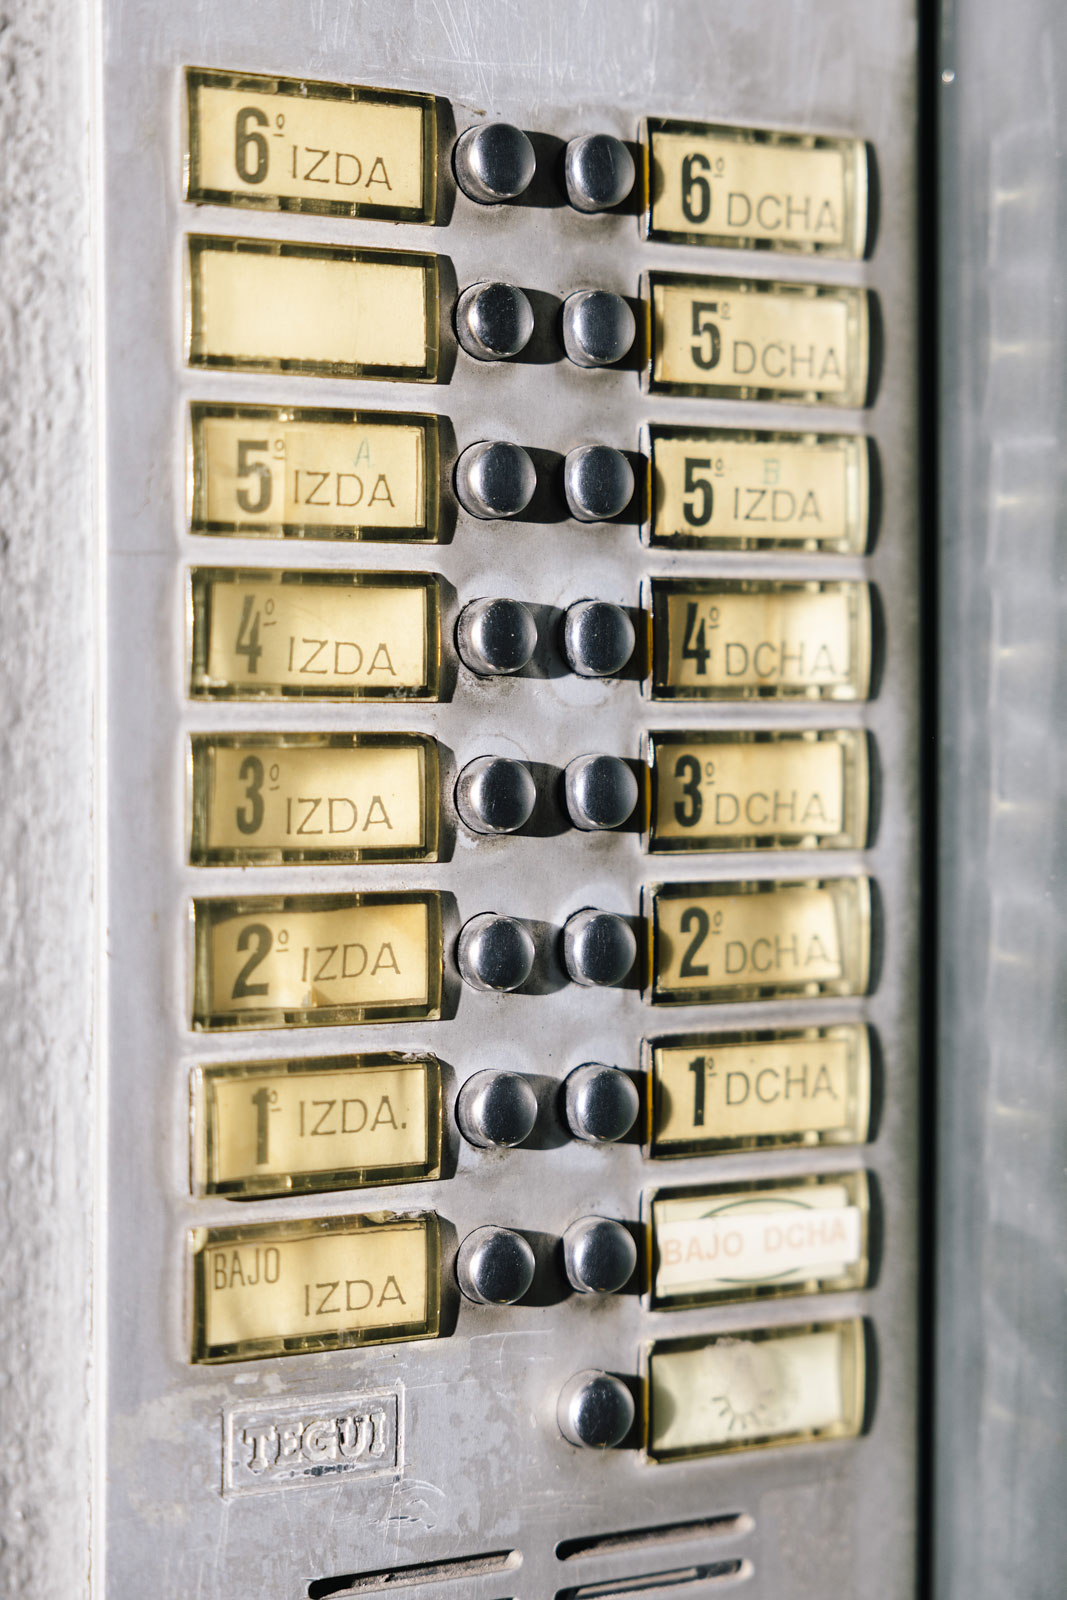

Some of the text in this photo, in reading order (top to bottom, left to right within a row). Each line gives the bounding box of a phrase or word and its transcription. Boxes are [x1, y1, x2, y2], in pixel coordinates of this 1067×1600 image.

[291, 145, 393, 191] IZDA
[293, 470, 395, 507] IZDA
[732, 487, 823, 524] IZDA
[287, 636, 397, 677] IZDA
[285, 795, 393, 835] IZDA
[300, 942, 402, 983] IZDA
[298, 1095, 408, 1138] IZDA.
[663, 1217, 848, 1266] BAJO DCHA
[213, 1246, 407, 1317] BAJO IZDA
[241, 1408, 388, 1475] TEGUI
